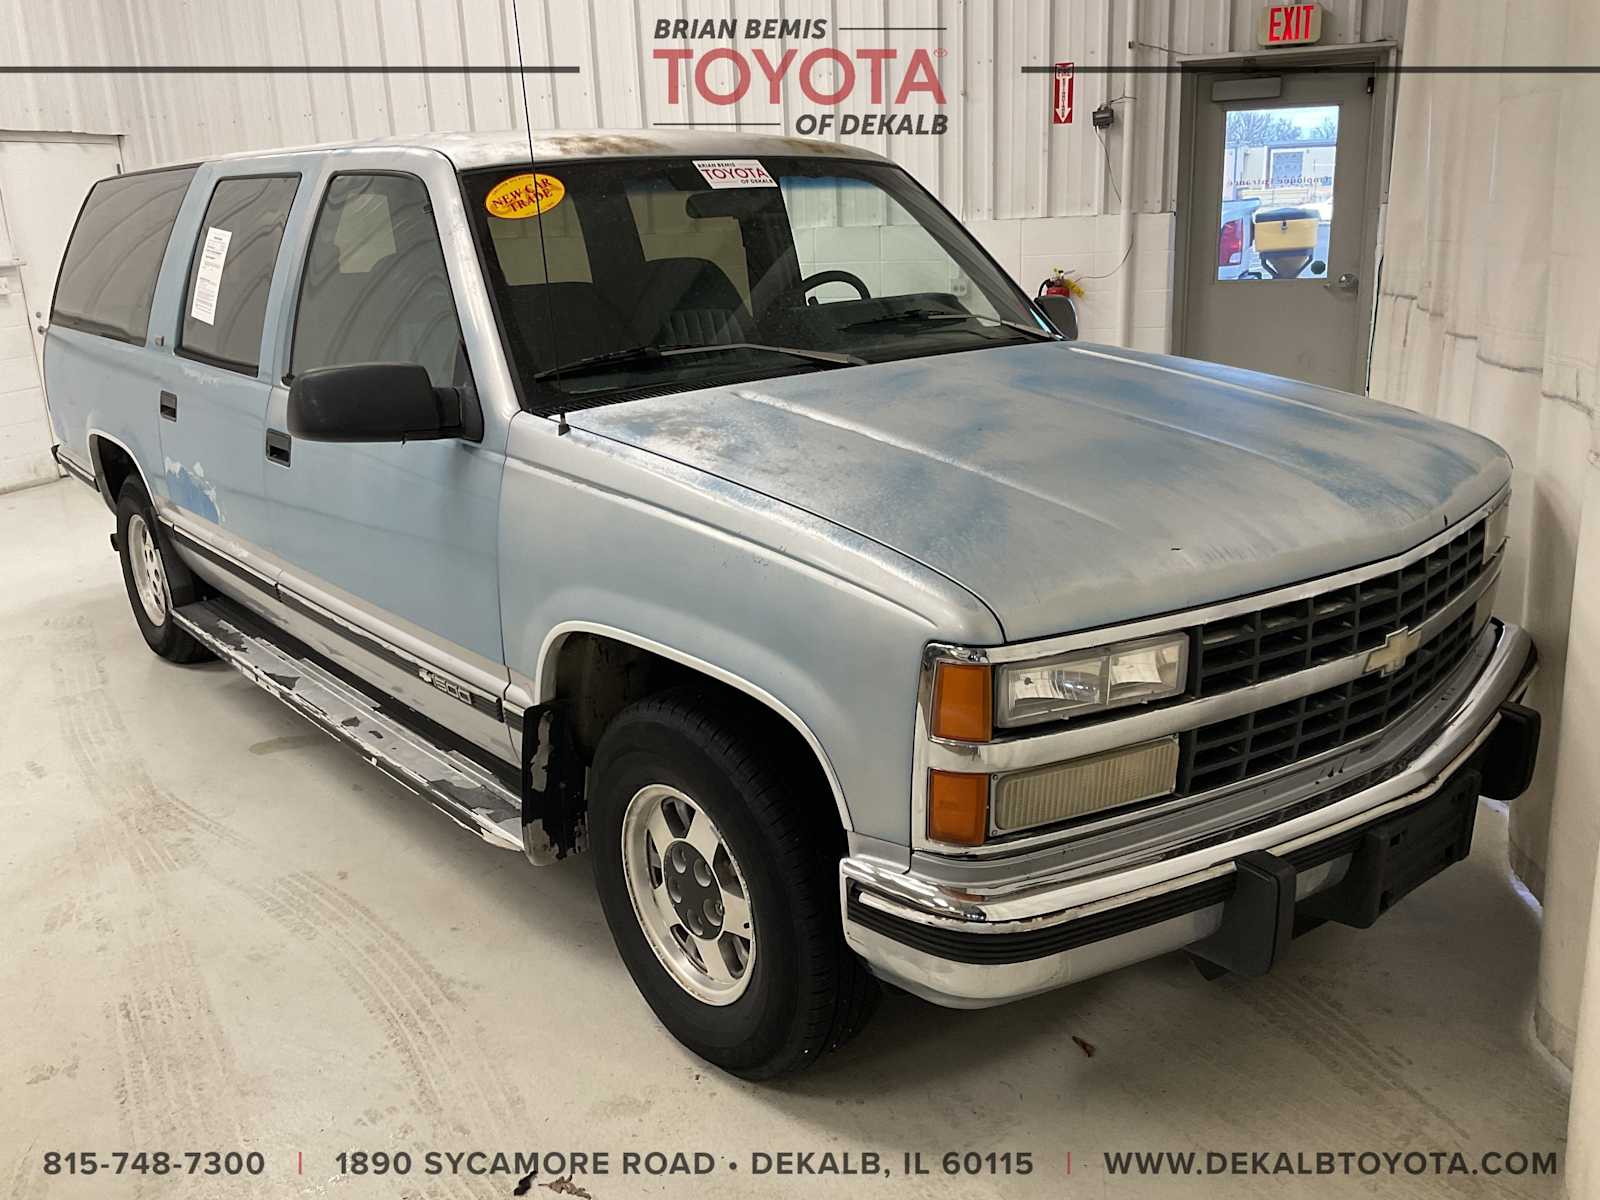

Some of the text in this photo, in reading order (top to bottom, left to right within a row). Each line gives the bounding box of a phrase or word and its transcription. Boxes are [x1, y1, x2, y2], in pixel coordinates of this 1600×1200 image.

[1269, 5, 1313, 42] EXIT
[700, 167, 769, 180] TOYOTA
[492, 188, 522, 207] NEW
[525, 178, 552, 194] CAR
[509, 188, 553, 212] TRADE
